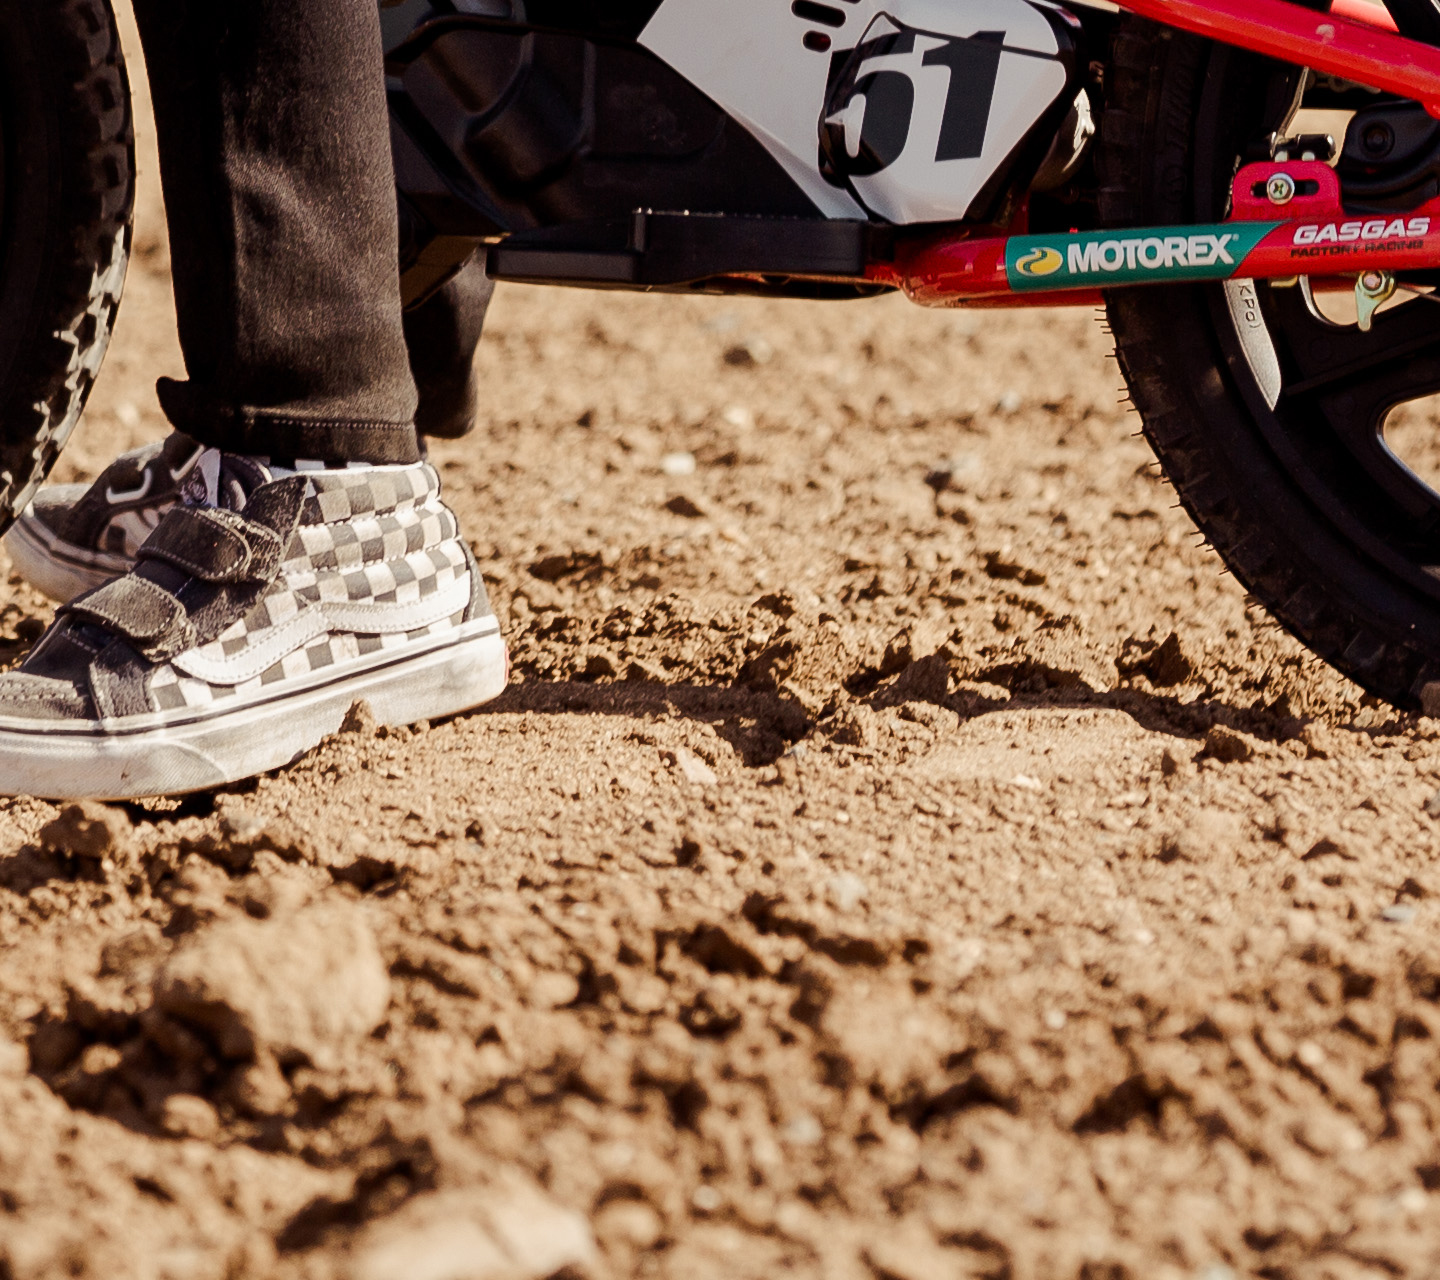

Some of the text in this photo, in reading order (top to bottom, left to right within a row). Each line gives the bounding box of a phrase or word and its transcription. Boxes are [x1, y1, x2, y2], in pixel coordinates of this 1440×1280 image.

[819, 30, 1007, 183] 51
[1293, 217, 1431, 245] GASGAS
[1067, 233, 1235, 274] MOTOREX
